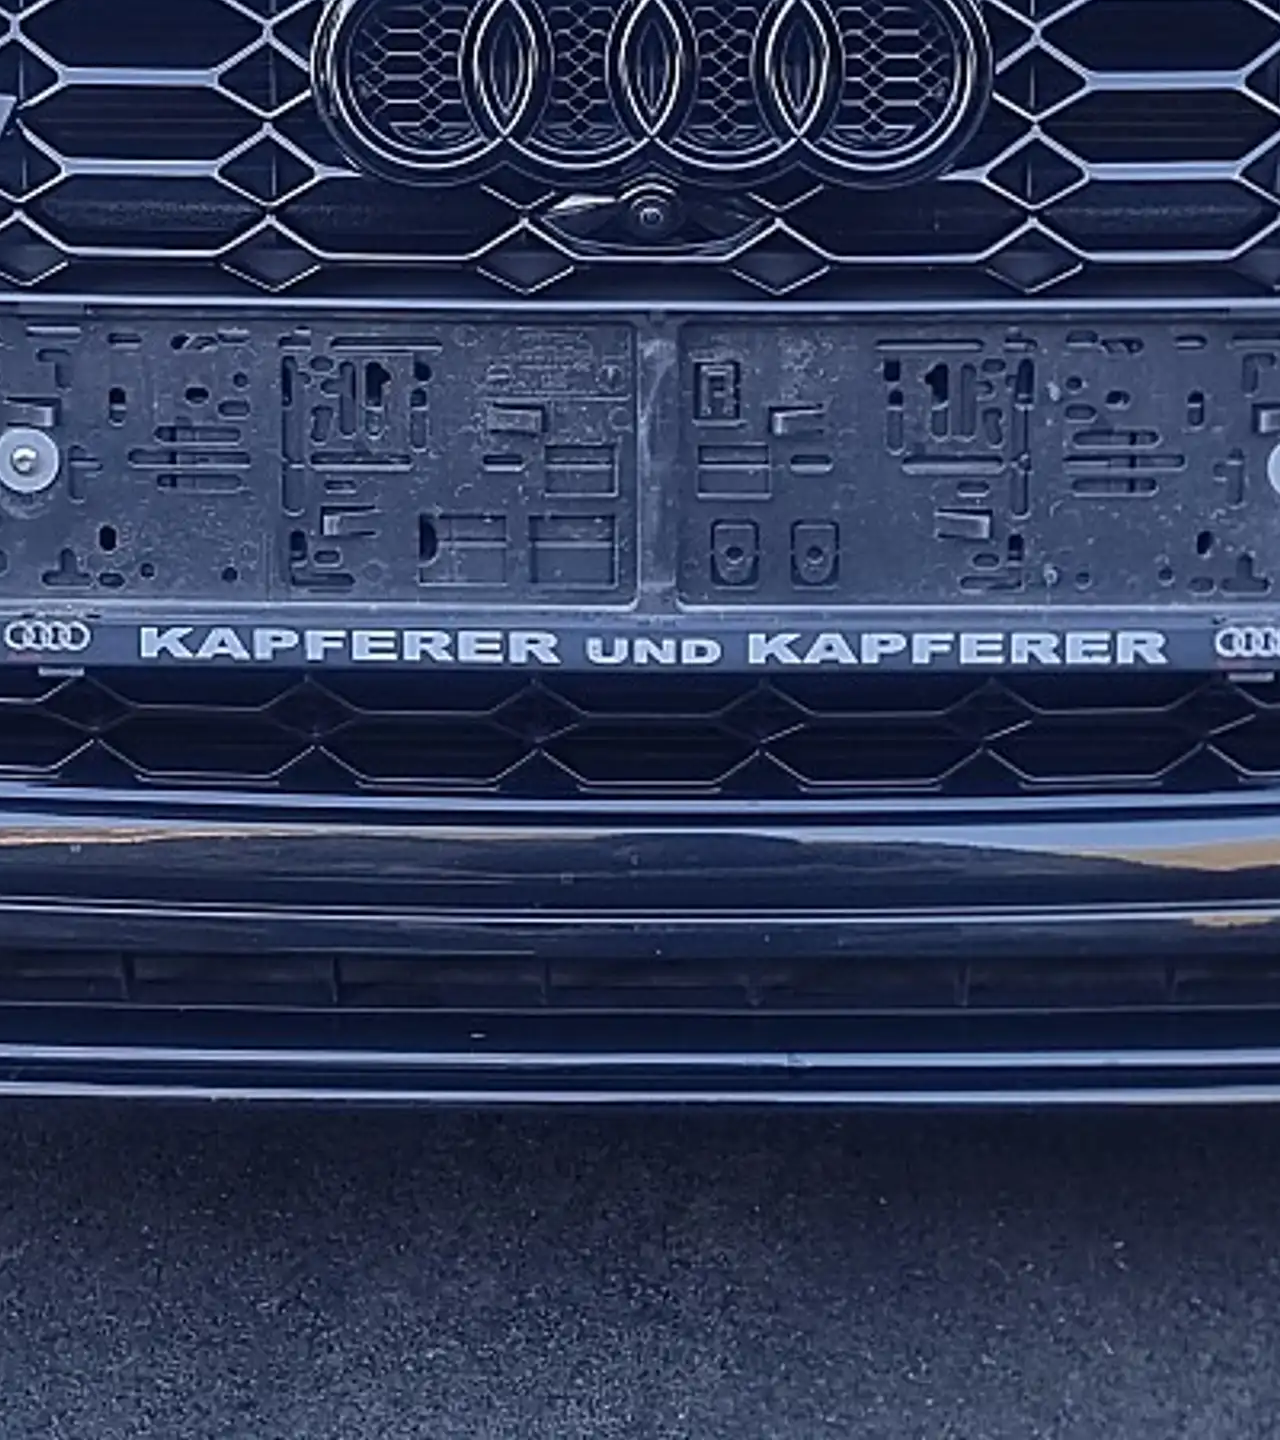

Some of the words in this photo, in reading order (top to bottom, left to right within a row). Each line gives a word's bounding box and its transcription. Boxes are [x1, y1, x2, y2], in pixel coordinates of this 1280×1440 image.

[140, 626, 560, 664] KAPFERER
[586, 638, 721, 665] UND
[748, 632, 1168, 665] KAPFERER
